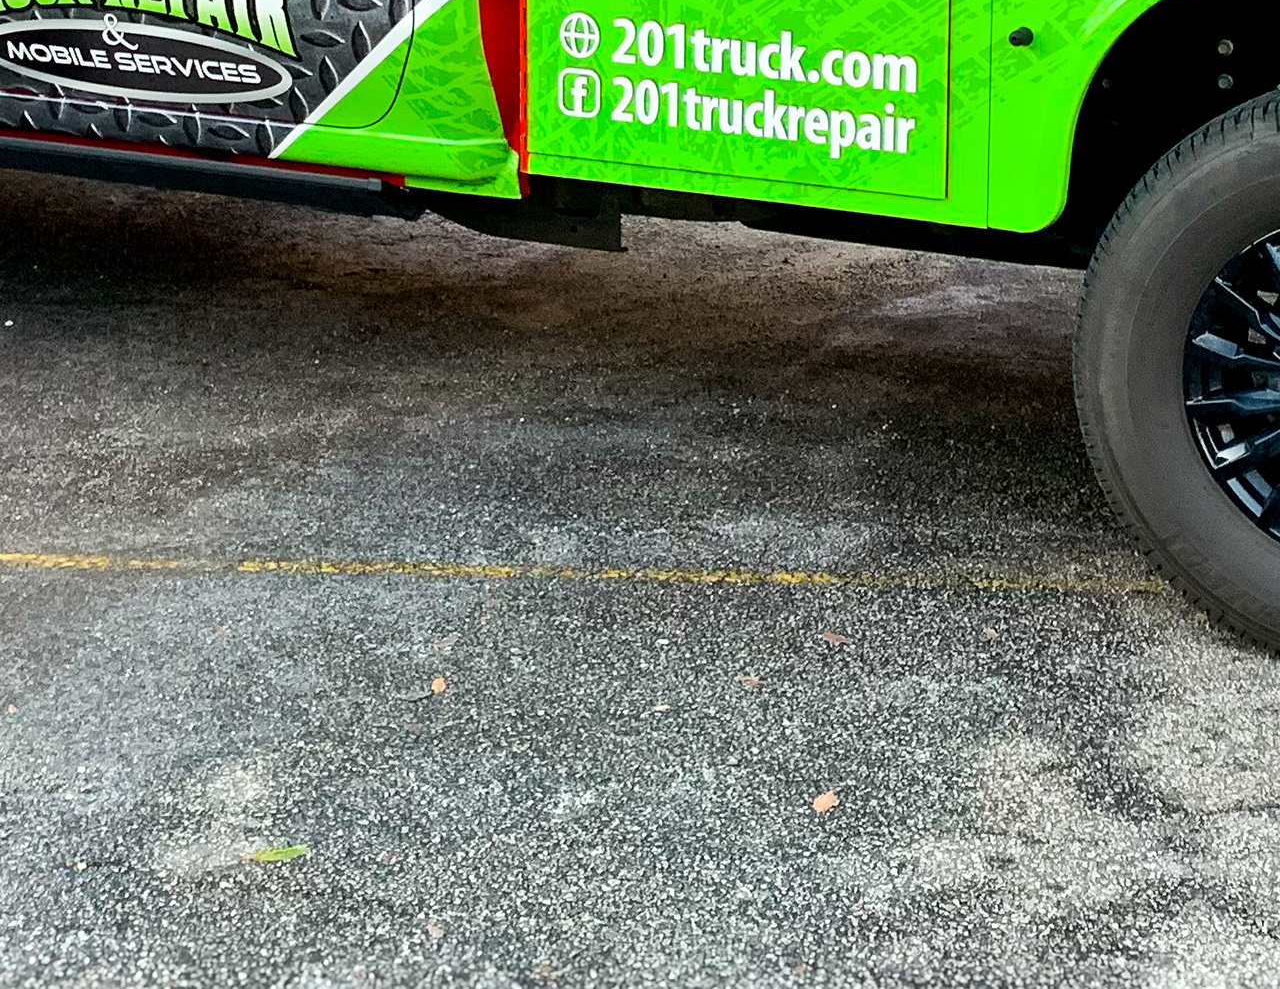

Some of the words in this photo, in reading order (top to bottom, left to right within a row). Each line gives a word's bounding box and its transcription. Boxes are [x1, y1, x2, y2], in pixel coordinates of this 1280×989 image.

[102, 13, 139, 50] &
[611, 17, 917, 93] 201truck.com
[7, 41, 112, 69] MOBILE
[113, 51, 262, 84] SERVICES
[611, 77, 916, 159] 201truckrepair
